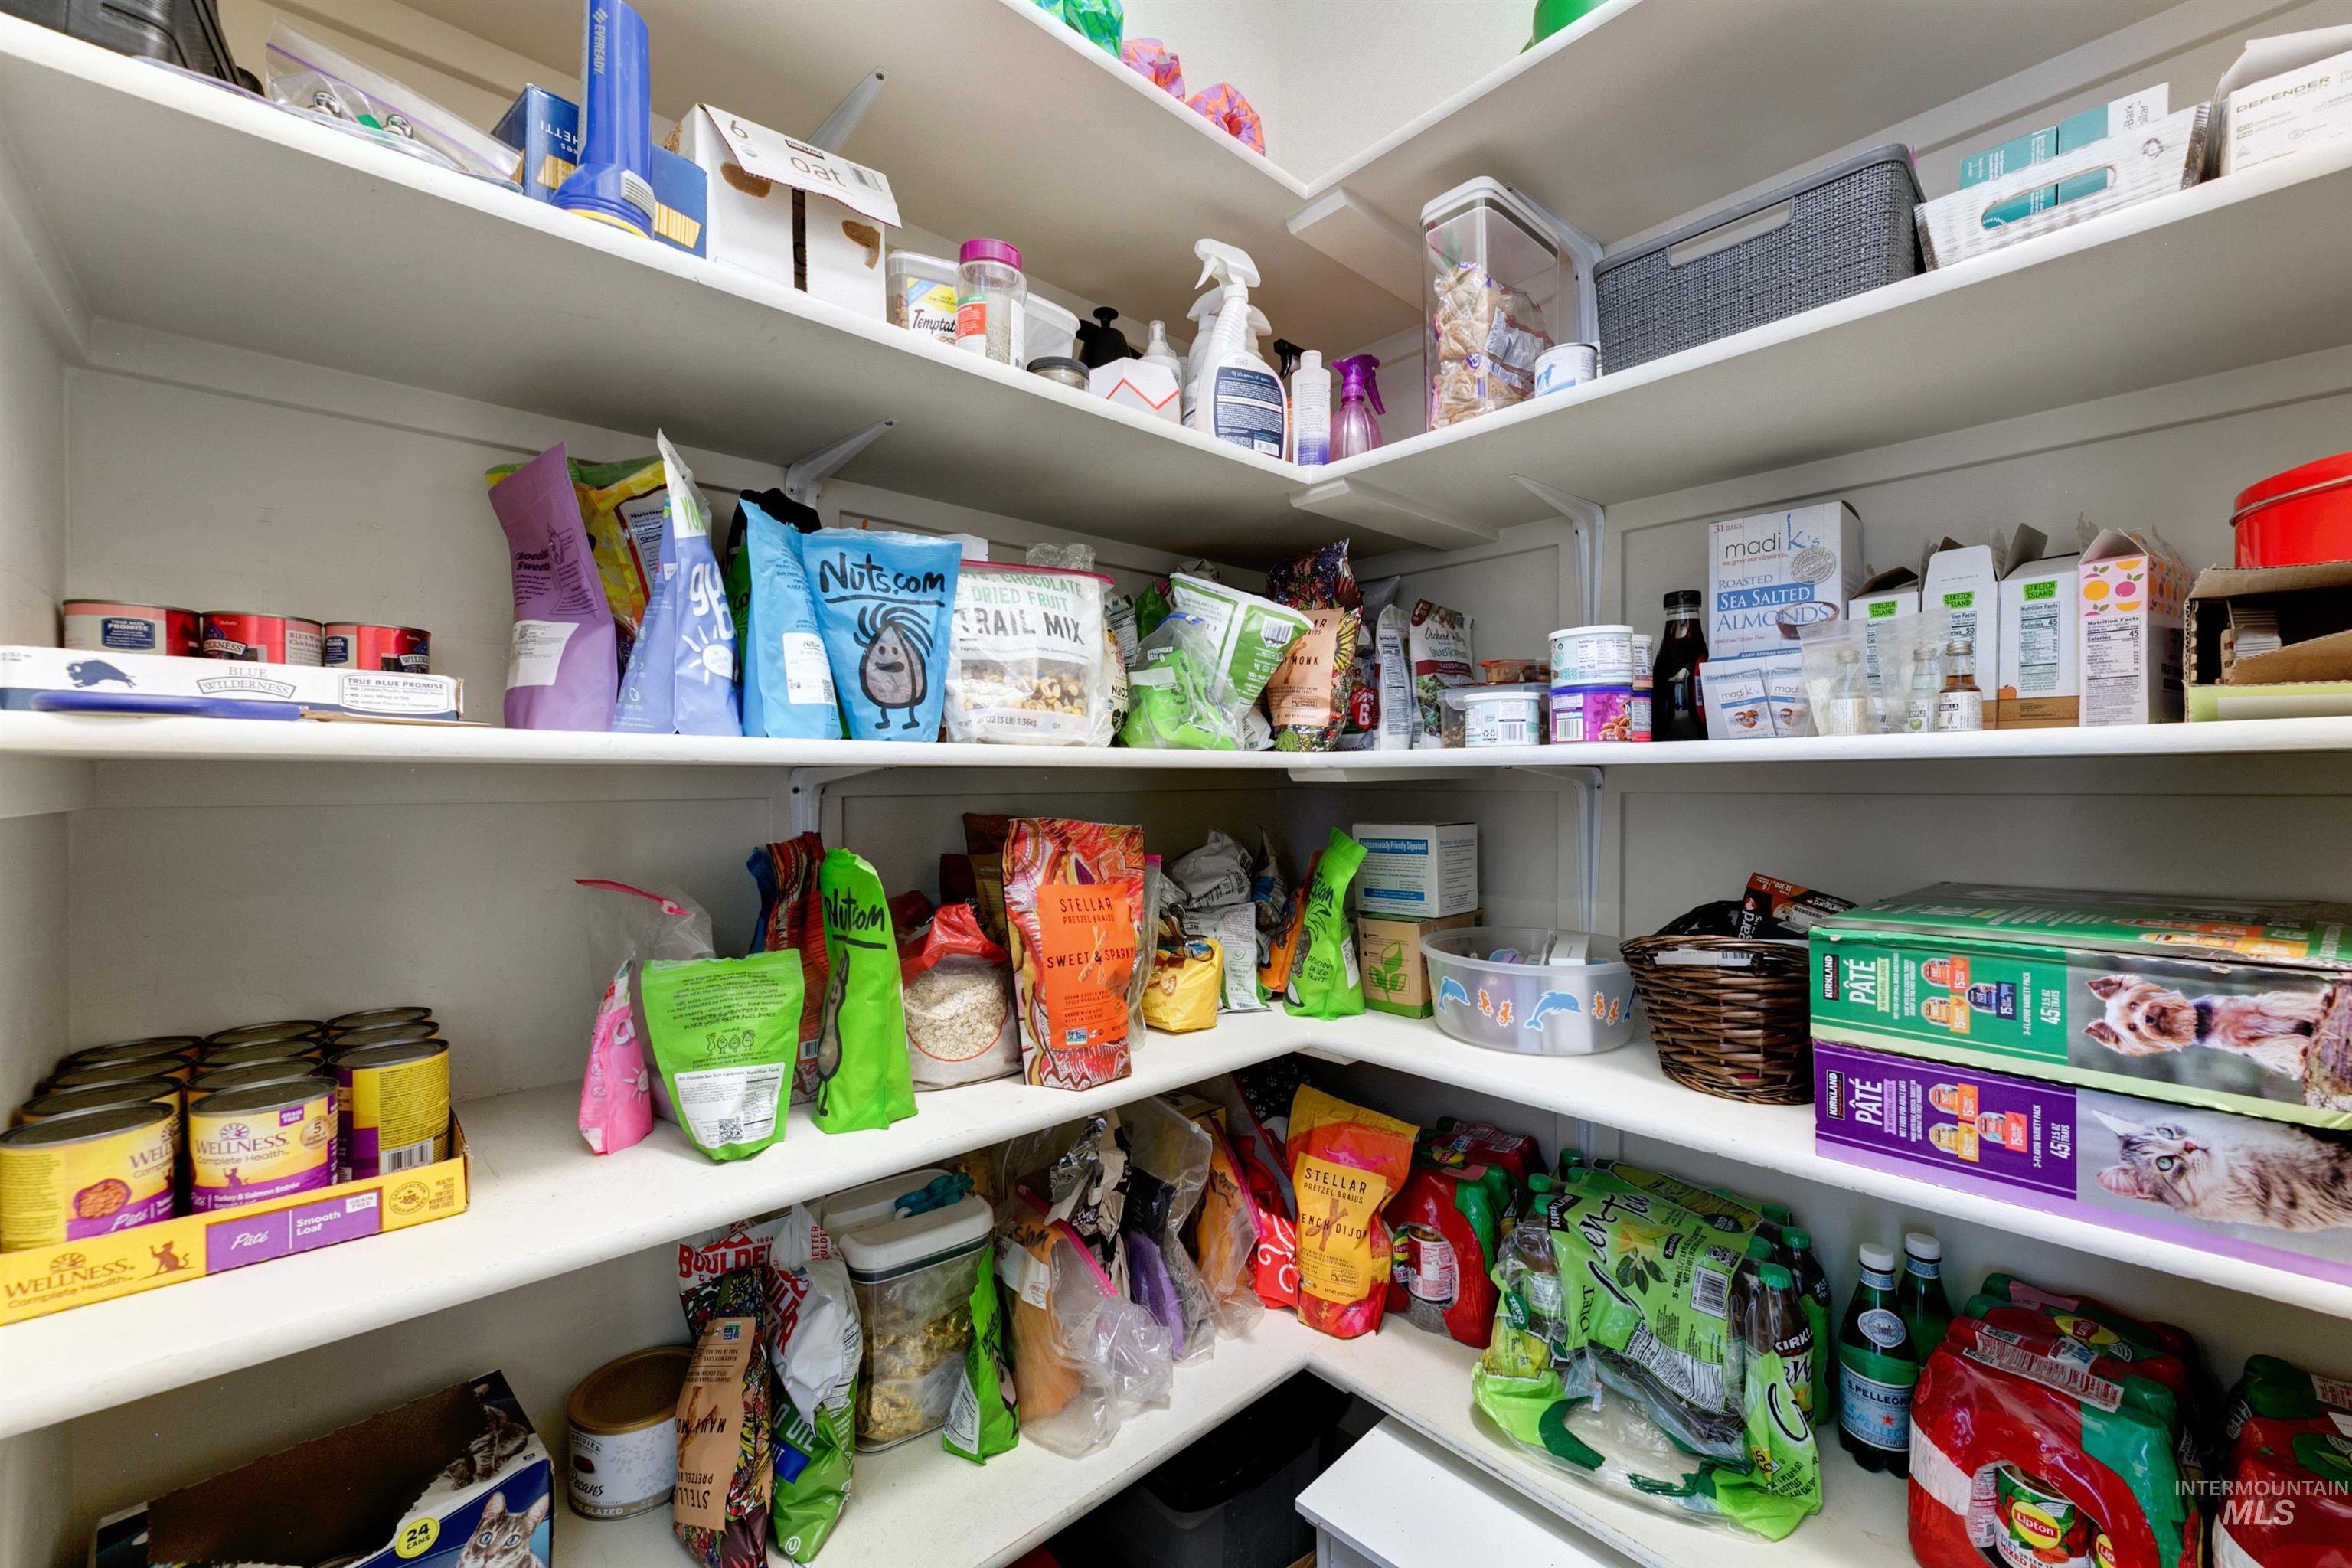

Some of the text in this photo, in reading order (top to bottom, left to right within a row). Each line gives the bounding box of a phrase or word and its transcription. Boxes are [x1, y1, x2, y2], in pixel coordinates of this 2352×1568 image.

[2236, 76, 2330, 113] DEFENDER
[541, 119, 579, 144] HETTI
[791, 156, 846, 187] oat
[913, 309, 956, 334] Temptat
[1713, 524, 1723, 533] 31
[1726, 533, 1782, 558] madi
[820, 552, 945, 596] Nuts.com
[1719, 574, 1773, 590] ROASTED
[1001, 575, 1083, 598] CHOCOLATE
[2026, 582, 2056, 593] STRETCH
[971, 586, 1068, 612] DRIED FRUIT
[1870, 601, 1896, 610] STRETCH
[1945, 593, 1973, 602] STRETCH
[954, 607, 1085, 645] TRAIL MIX
[1292, 656, 1319, 665] MONK
[229, 666, 267, 678] BLUE
[203, 678, 289, 696] WILDERNESS
[403, 681, 444, 689] PROMISE
[1005, 717, 1016, 726] LB)
[1018, 718, 1037, 728] 1.36kg
[1359, 704, 1370, 725] 6
[1060, 897, 1113, 913] STELLAR
[1063, 915, 1092, 926] PRETZEL
[1047, 947, 1135, 969] SWEET & SPARKY
[1308, 956, 1334, 971] DELICIOUS
[1308, 965, 1328, 976] DRIED
[1308, 973, 1328, 983] FRUIT
[1824, 956, 1833, 998] KIRKLAND
[1843, 959, 1876, 1004] PÂTÉ
[1954, 980, 1966, 989] 15
[2023, 972, 2031, 1036] 3-FLAVOR VARIETY PACK
[2042, 997, 2050, 1006] 3.5
[2051, 989, 2060, 1007] TRAYS
[2001, 1005, 2013, 1014] 15
[2040, 1008, 2060, 1025] 45
[1955, 1019, 1966, 1029] 15
[1829, 1073, 1838, 1116] KIRKLAND
[1848, 1078, 1883, 1125] PÂTÉ
[281, 1109, 303, 1119] GRAIN
[1963, 1108, 1975, 1117] 15
[314, 1122, 322, 1135] 5
[2033, 1104, 2041, 1168] 3-FLAVOR VARIETY PACK
[2051, 1122, 2060, 1140] 3.5 OZ
[2061, 1124, 2070, 1142] TRAYS
[195, 1132, 288, 1155] WELLNESS
[2011, 1137, 2023, 1145] 15
[197, 1148, 285, 1166] Complete Health
[1964, 1147, 1975, 1156] 15
[2050, 1142, 2071, 1159] 45
[1305, 1168, 1367, 1194] STELLAR
[214, 1194, 237, 1203] Turkey
[245, 1188, 274, 1200] Salmon
[349, 1196, 374, 1205] GRAIN
[1304, 1182, 1364, 1204] PRETZEL BRAIDS
[352, 1200, 371, 1209] FREE
[1551, 1194, 1574, 1227] KIRKLAND
[296, 1211, 341, 1227] Smooth
[1302, 1213, 1330, 1230] ENCH
[296, 1223, 322, 1236] Loaf
[756, 1236, 774, 1244] 1994
[1665, 1243, 1674, 1256] Zero
[8, 1275, 126, 1310] Complete Health
[1509, 1295, 1525, 1325] ZERO
[1580, 1285, 1595, 1334] DIET
[1775, 1328, 1813, 1351] KIRKL
[696, 1418, 727, 1433] MAUI
[570, 1466, 605, 1497] Pecans
[684, 1472, 714, 1484] PRETZEL
[678, 1488, 710, 1509] STELL
[584, 1507, 624, 1516] GLAZED
[2017, 1512, 2055, 1536] Lipton
[406, 1535, 431, 1549] CANS
[407, 1523, 429, 1544] 24
[2001, 1534, 2018, 1552] DIET
[2001, 1542, 2027, 1566] MIXED
[2019, 1551, 2043, 1566] GREEN
